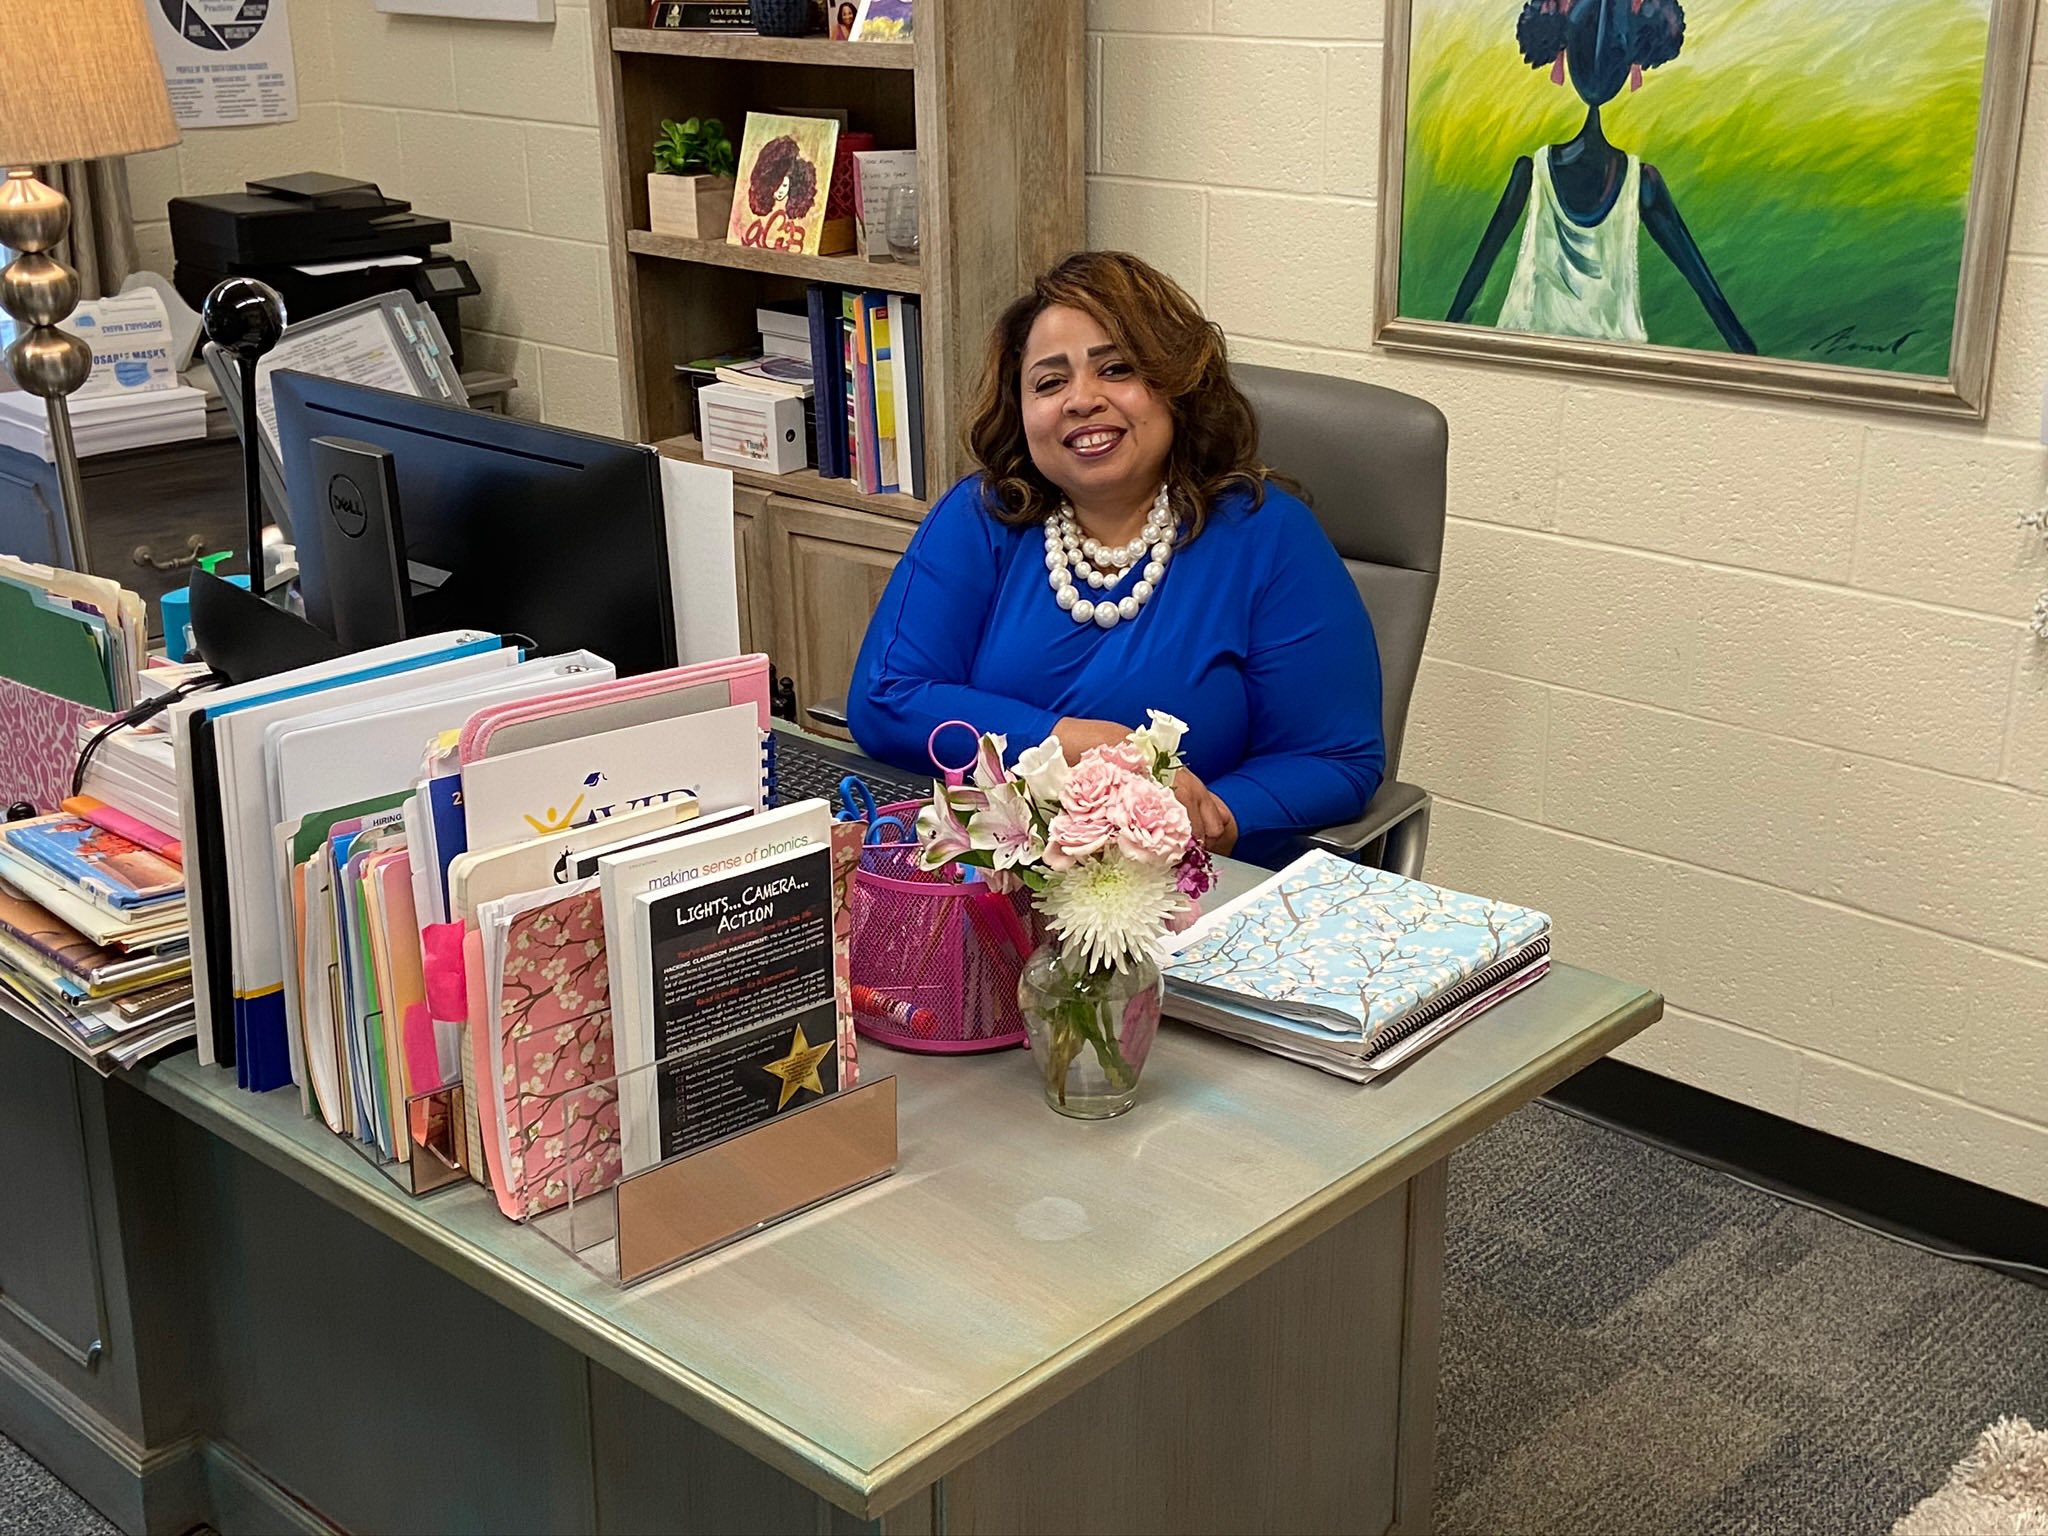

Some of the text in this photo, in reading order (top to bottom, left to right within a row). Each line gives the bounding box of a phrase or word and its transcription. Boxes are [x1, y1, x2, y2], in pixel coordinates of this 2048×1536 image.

[452, 792, 462, 805] 2
[373, 814, 402, 826] HIRING
[702, 856, 742, 876] sense
[745, 848, 758, 867] of
[760, 835, 808, 860] phonics
[718, 902, 773, 934] ACTION
